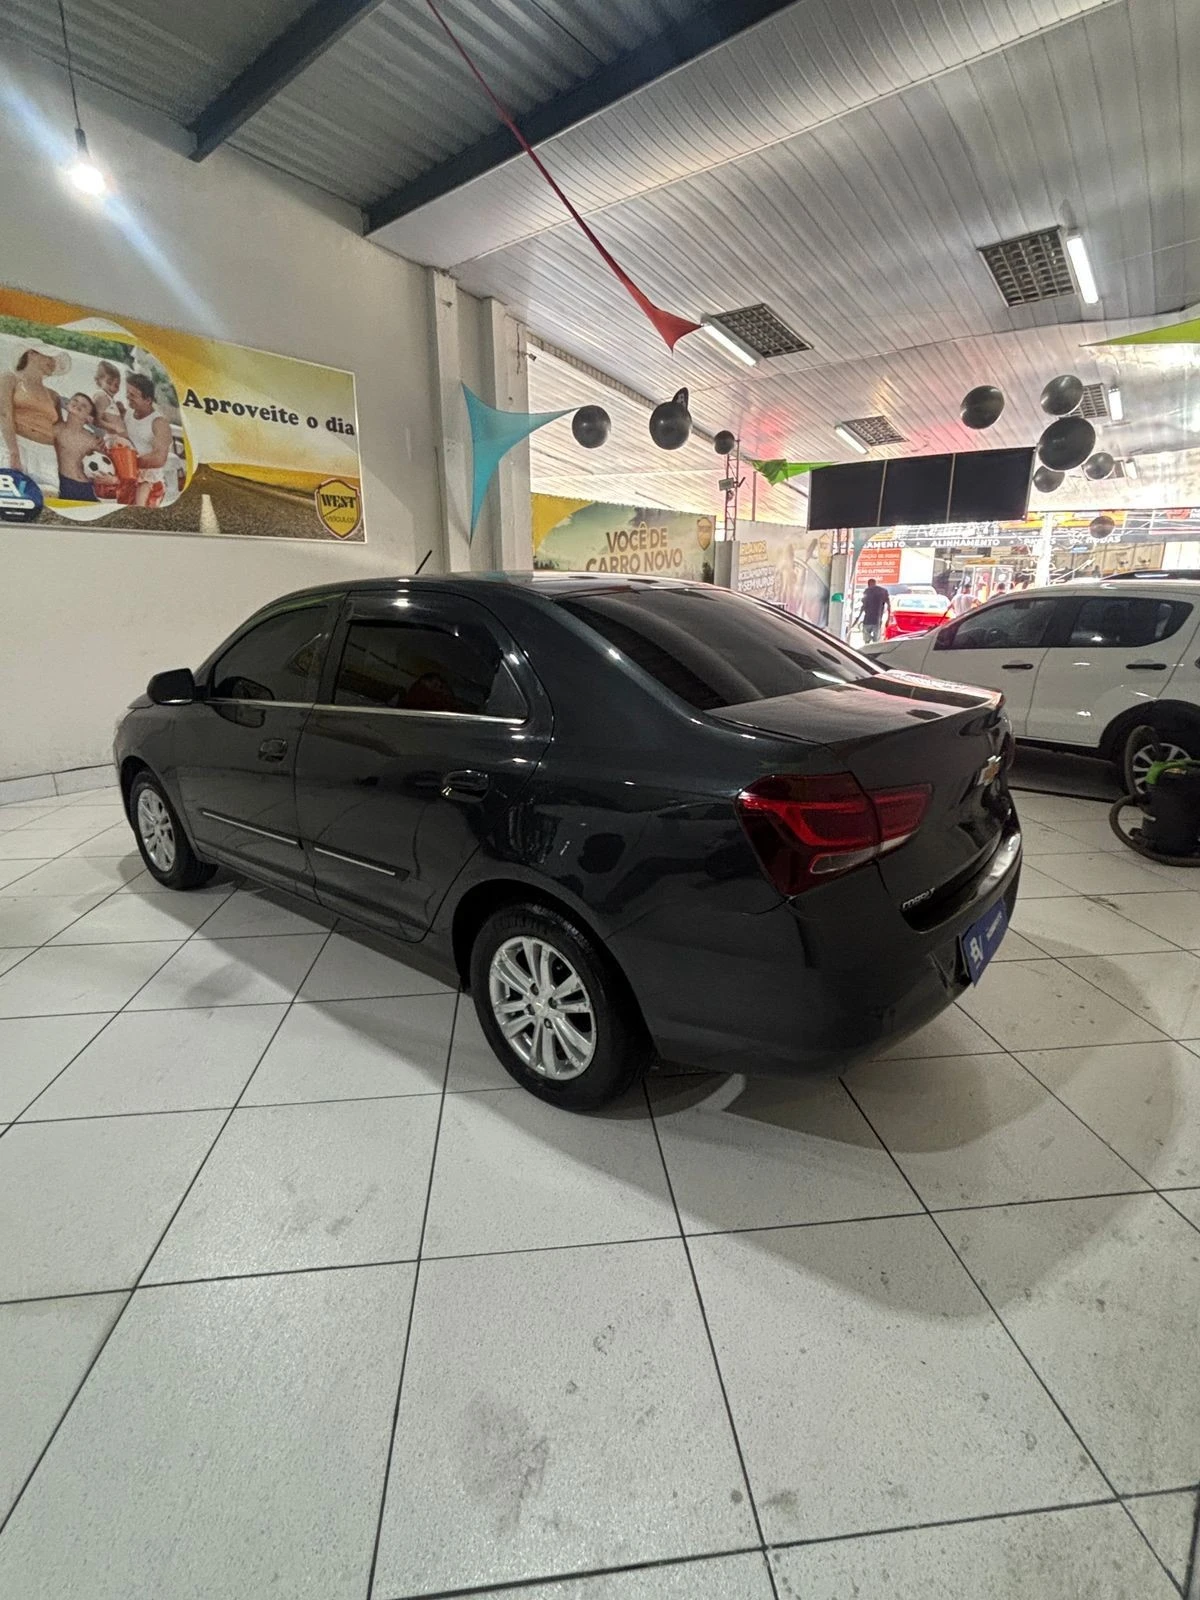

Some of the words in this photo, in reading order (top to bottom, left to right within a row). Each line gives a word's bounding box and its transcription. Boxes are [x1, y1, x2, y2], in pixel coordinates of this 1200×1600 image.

[183, 388, 299, 426] Aproveite
[306, 416, 318, 429] o
[325, 415, 355, 436] dia
[321, 494, 356, 509] WEST
[606, 522, 647, 553] VOCÊ
[649, 528, 668, 548] DE
[930, 539, 1000, 547] ALINHAMENTO
[586, 552, 641, 572] CARRO
[644, 548, 683, 570] NOVO
